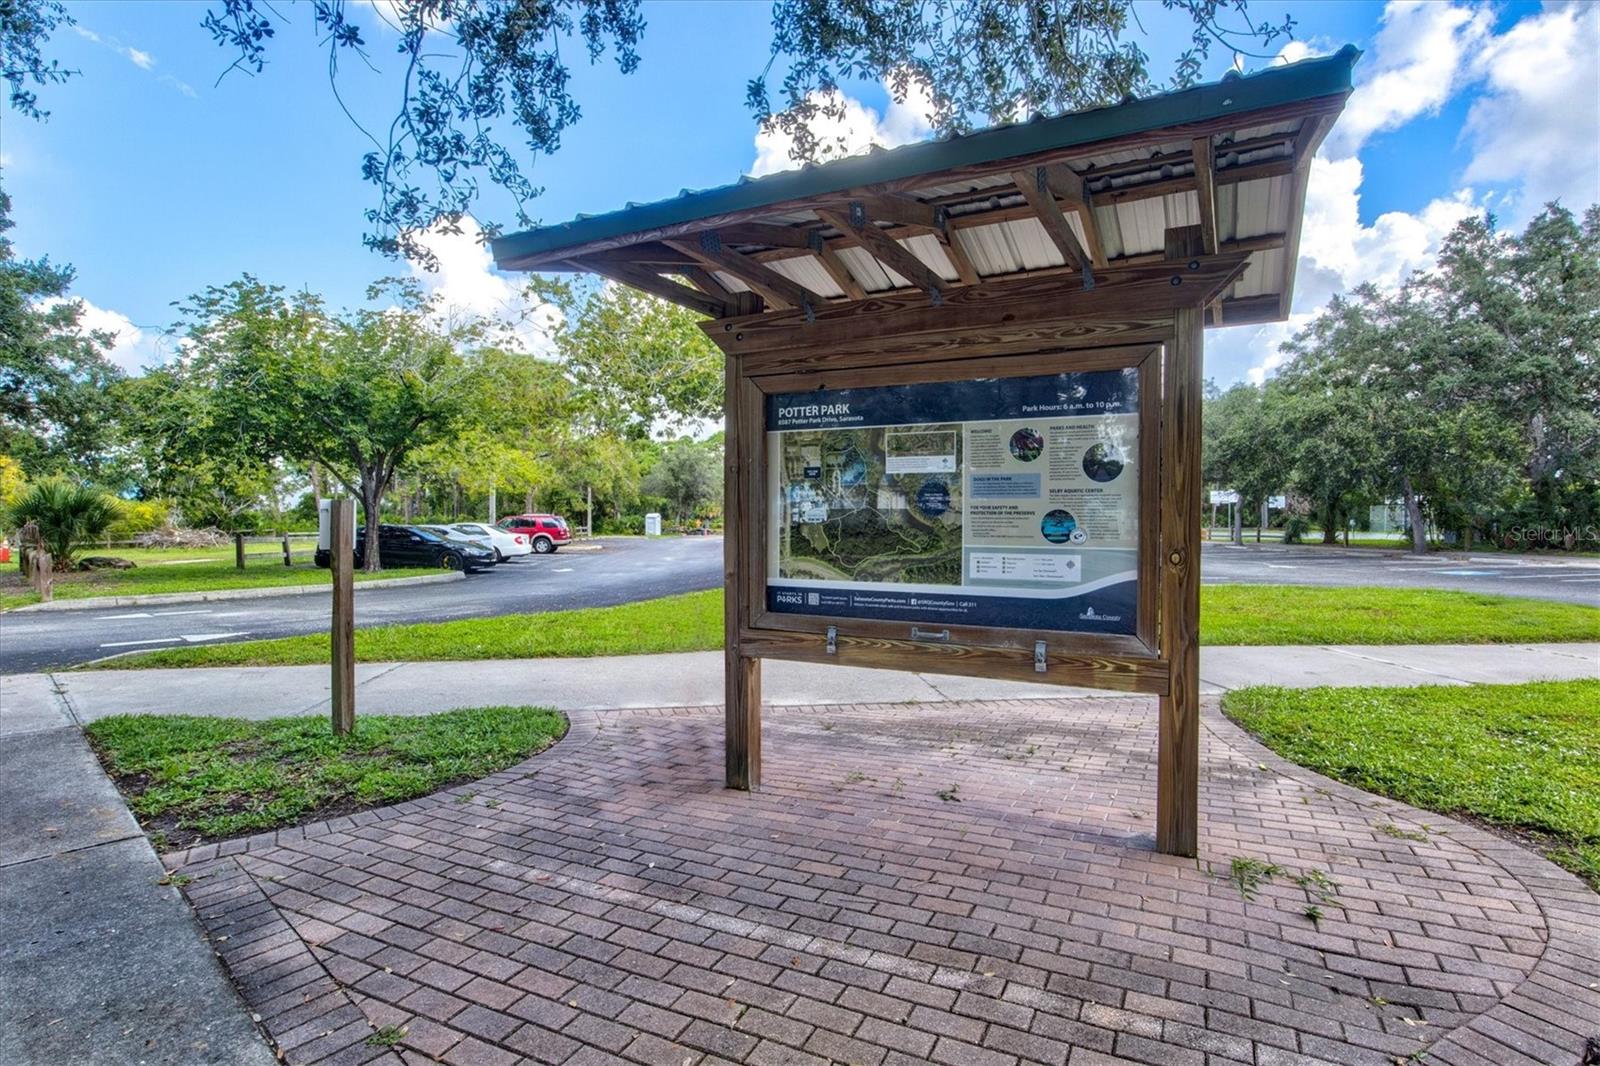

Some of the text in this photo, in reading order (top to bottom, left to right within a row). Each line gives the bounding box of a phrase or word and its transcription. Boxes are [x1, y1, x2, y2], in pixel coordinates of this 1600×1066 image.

[778, 403, 850, 418] POTTER PARK
[776, 595, 803, 604] PARKS
